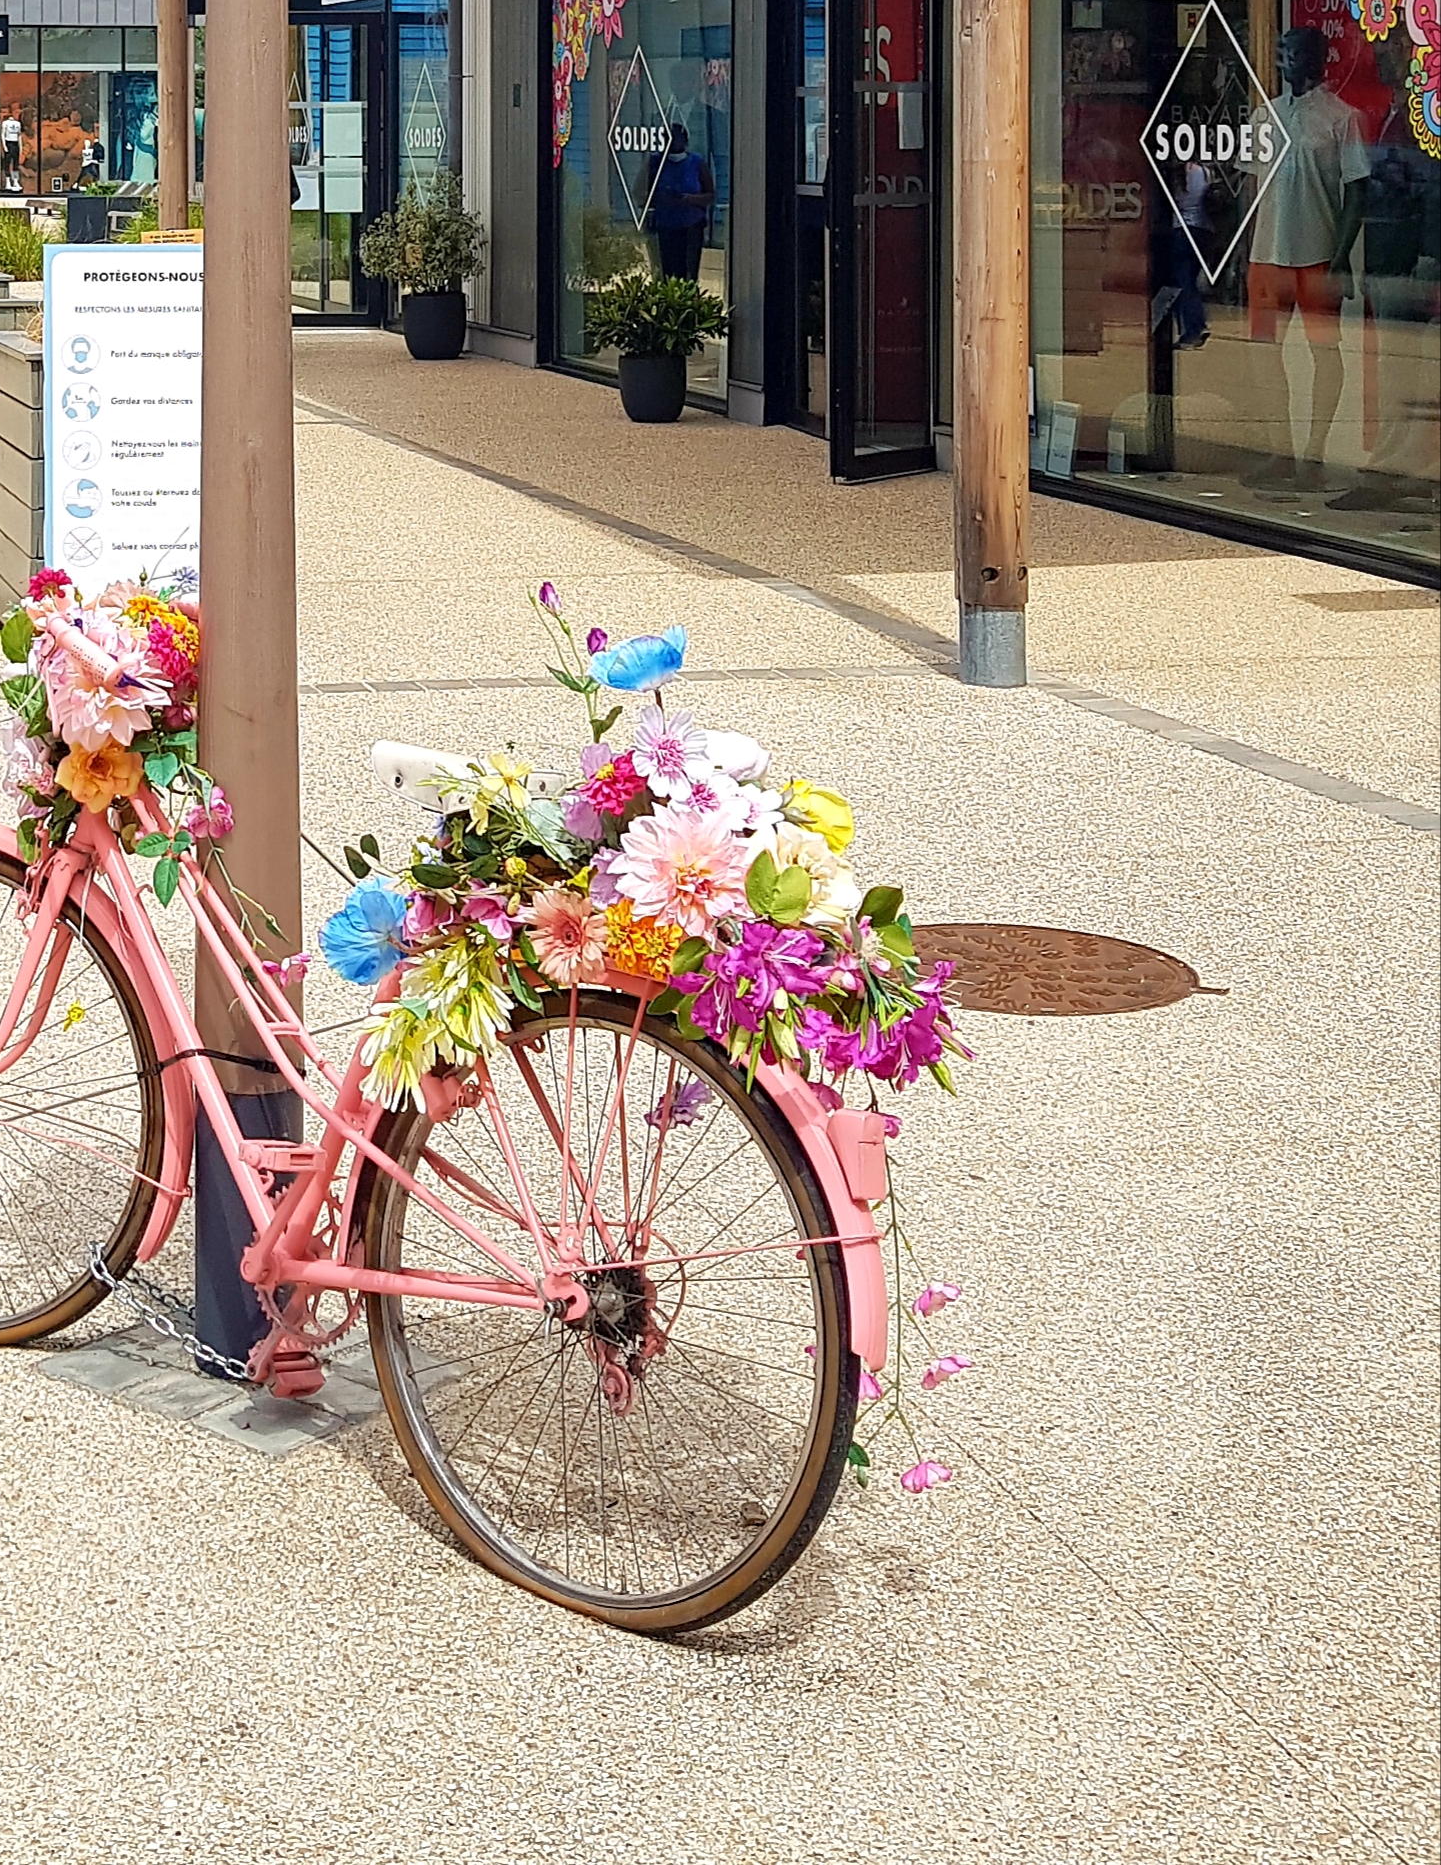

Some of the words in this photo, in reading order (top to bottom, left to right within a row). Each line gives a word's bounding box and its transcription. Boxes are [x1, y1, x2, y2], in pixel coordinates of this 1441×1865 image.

[409, 127, 442, 148] SOLDES
[614, 126, 666, 153] SOLDES
[1155, 123, 1275, 163] SOLDES
[84, 269, 204, 283] PROTÉGEONS-NOUS
